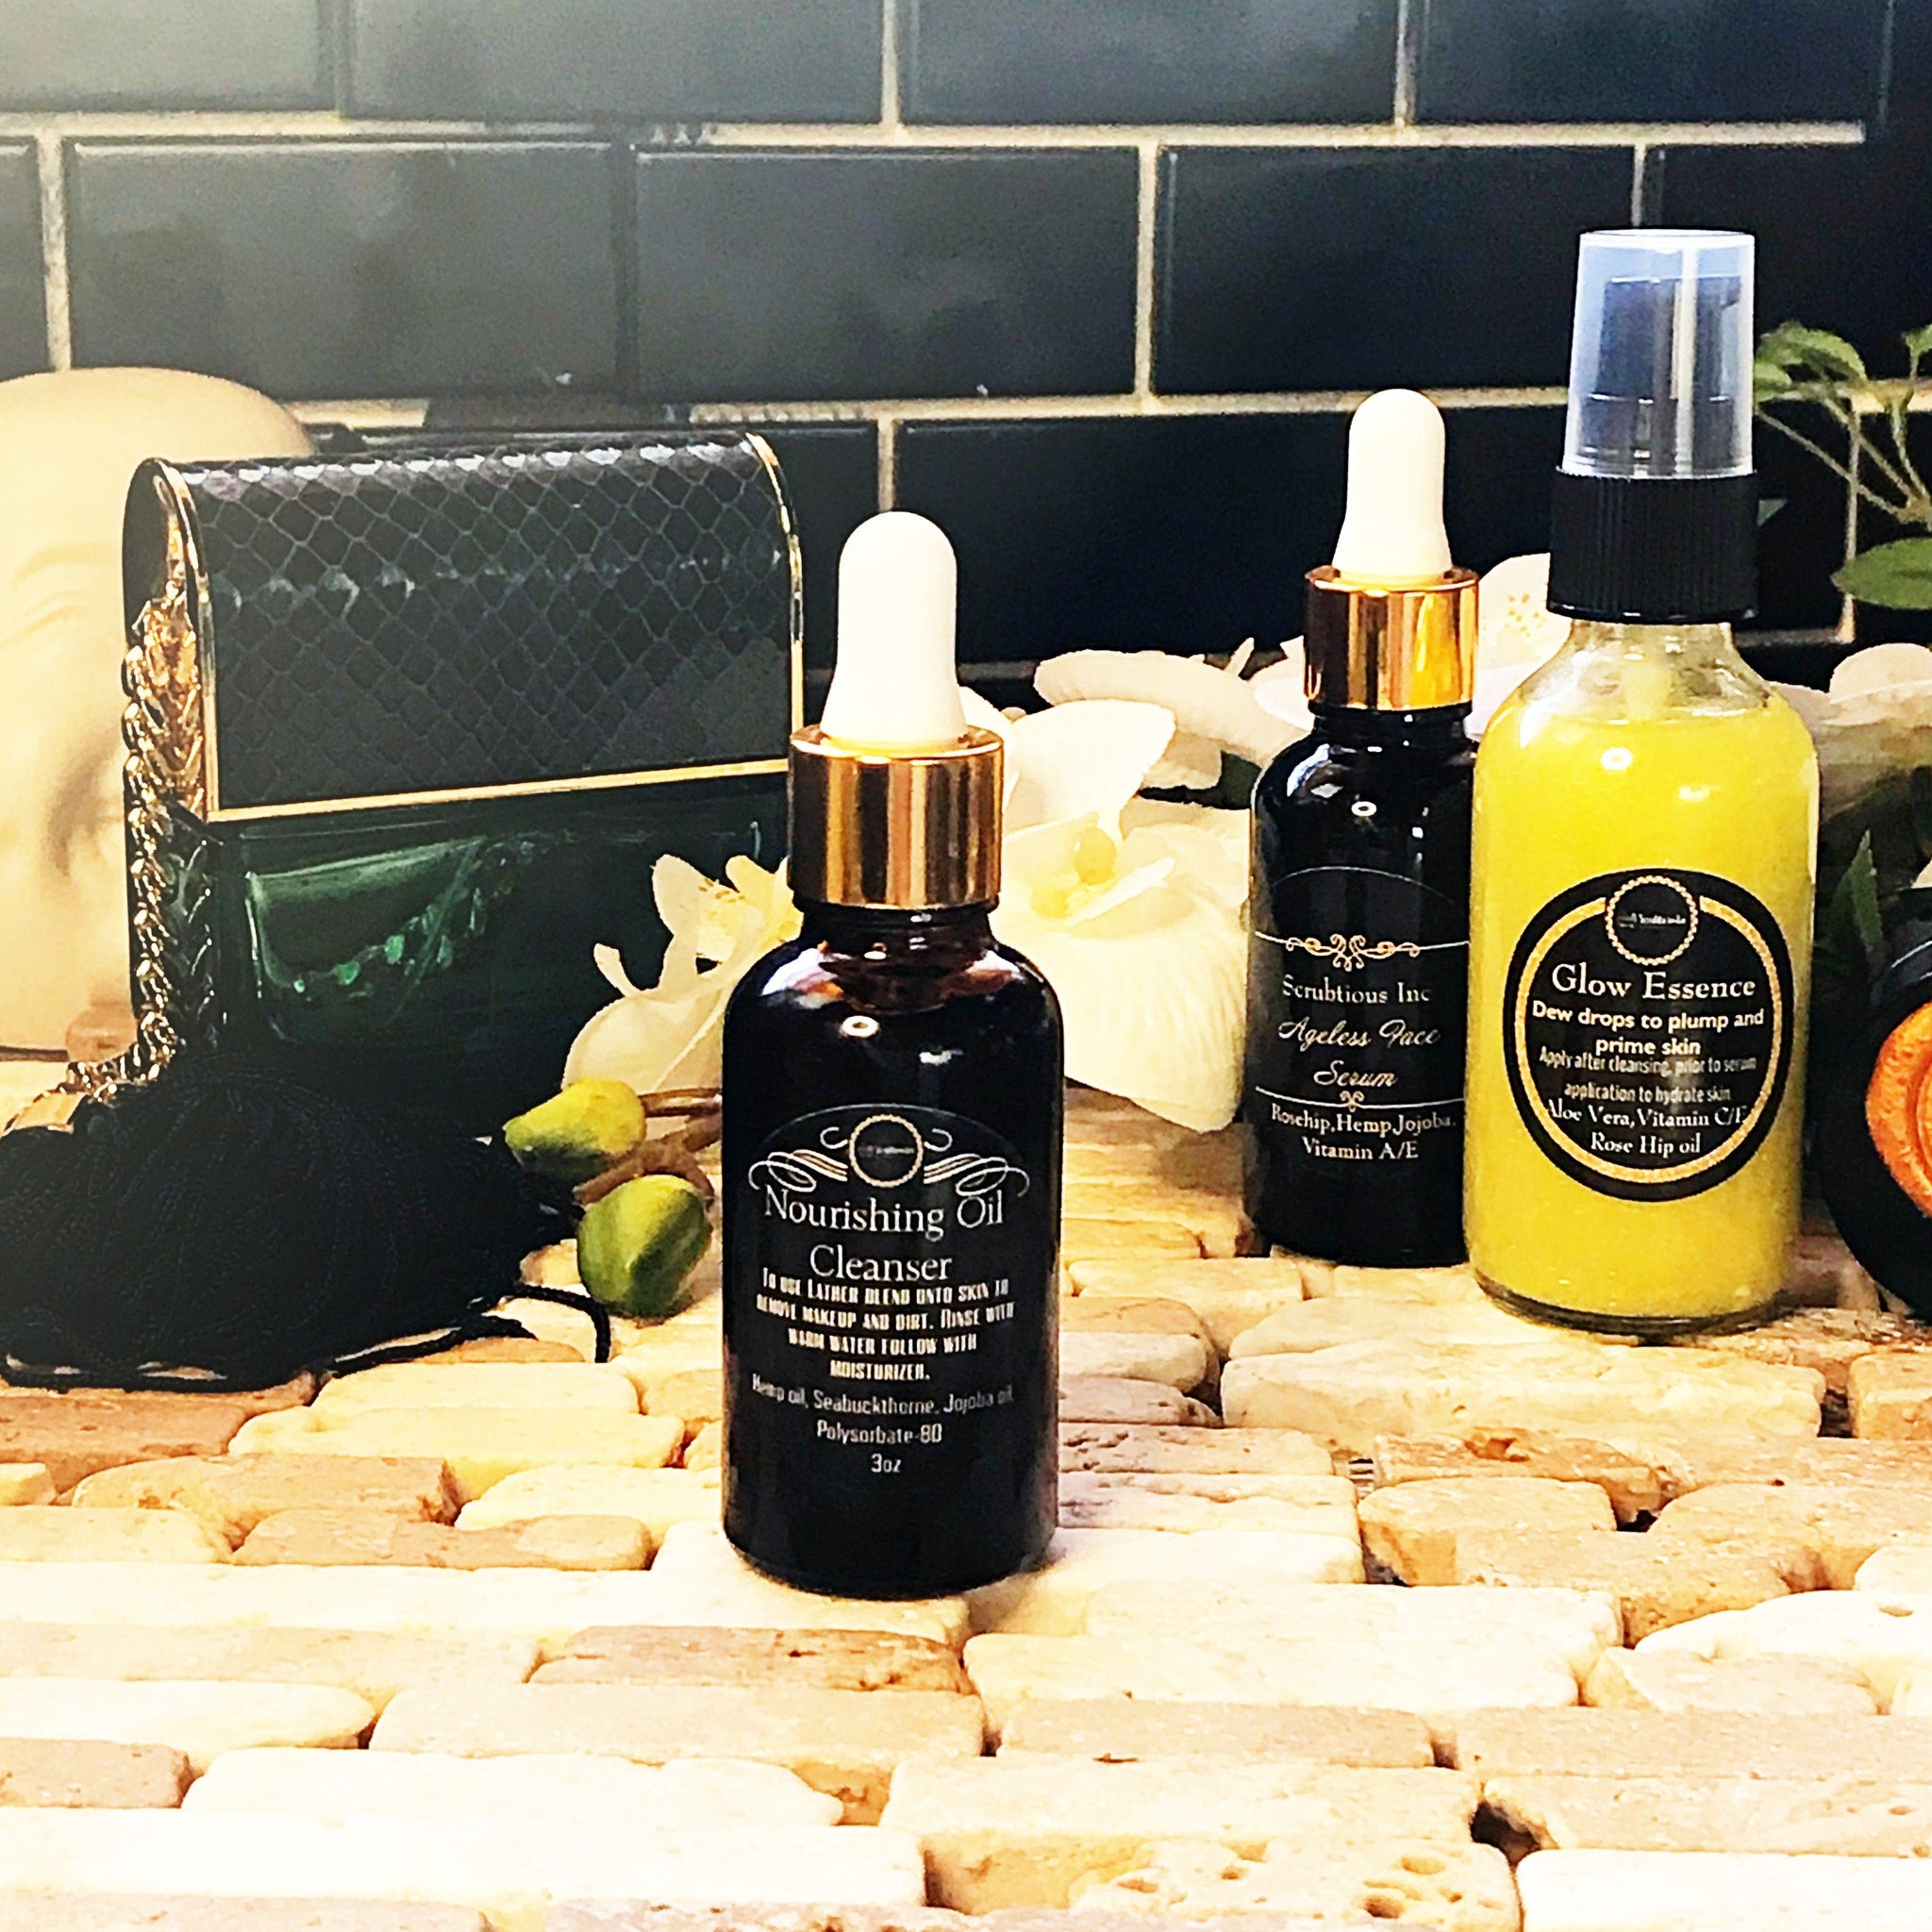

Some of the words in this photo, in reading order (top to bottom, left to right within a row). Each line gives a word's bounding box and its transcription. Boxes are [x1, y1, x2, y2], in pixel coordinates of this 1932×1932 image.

[1282, 974, 1389, 1004] Scrubtious
[1397, 981, 1431, 1003] Inc
[1552, 961, 1632, 997] Glow
[1642, 971, 1756, 1000] Essence
[1532, 1000, 1574, 1022] Dew
[1577, 1007, 1635, 1032] drops
[1641, 1015, 1663, 1029] to
[1668, 1012, 1729, 1034] plump
[1734, 1008, 1764, 1027] and
[1278, 1016, 1372, 1052] Ageless
[1379, 1019, 1441, 1048] Face
[1595, 1036, 1657, 1057] prime
[1661, 1038, 1701, 1056] skin
[1313, 1059, 1398, 1087] Serum
[1539, 1045, 1573, 1069] Apply
[1574, 1052, 1606, 1071] after
[1674, 1058, 1706, 1077] prior
[1707, 1057, 1721, 1073] to
[1564, 1081, 1636, 1102] application
[1639, 1086, 1653, 1103] to
[1656, 1085, 1705, 1106] hydrate
[1707, 1085, 1731, 1102] skin
[1548, 1097, 1583, 1122] Aloe
[1302, 1136, 1374, 1160] Vitamin
[1378, 1141, 1419, 1159] A/E
[1591, 1131, 1633, 1153] Rose
[1640, 1135, 1674, 1158] Hip
[1679, 1132, 1701, 1153] oil
[764, 1185, 943, 1241] Nourishing
[957, 1190, 1004, 1228] Oil
[809, 1244, 952, 1282] Cleanser
[862, 1313, 890, 1330] AND
[752, 1373, 785, 1403] Hemp
[943, 1391, 993, 1415] Jojoba
[997, 1384, 1014, 1405] oil
[871, 1453, 902, 1474] 3oz
